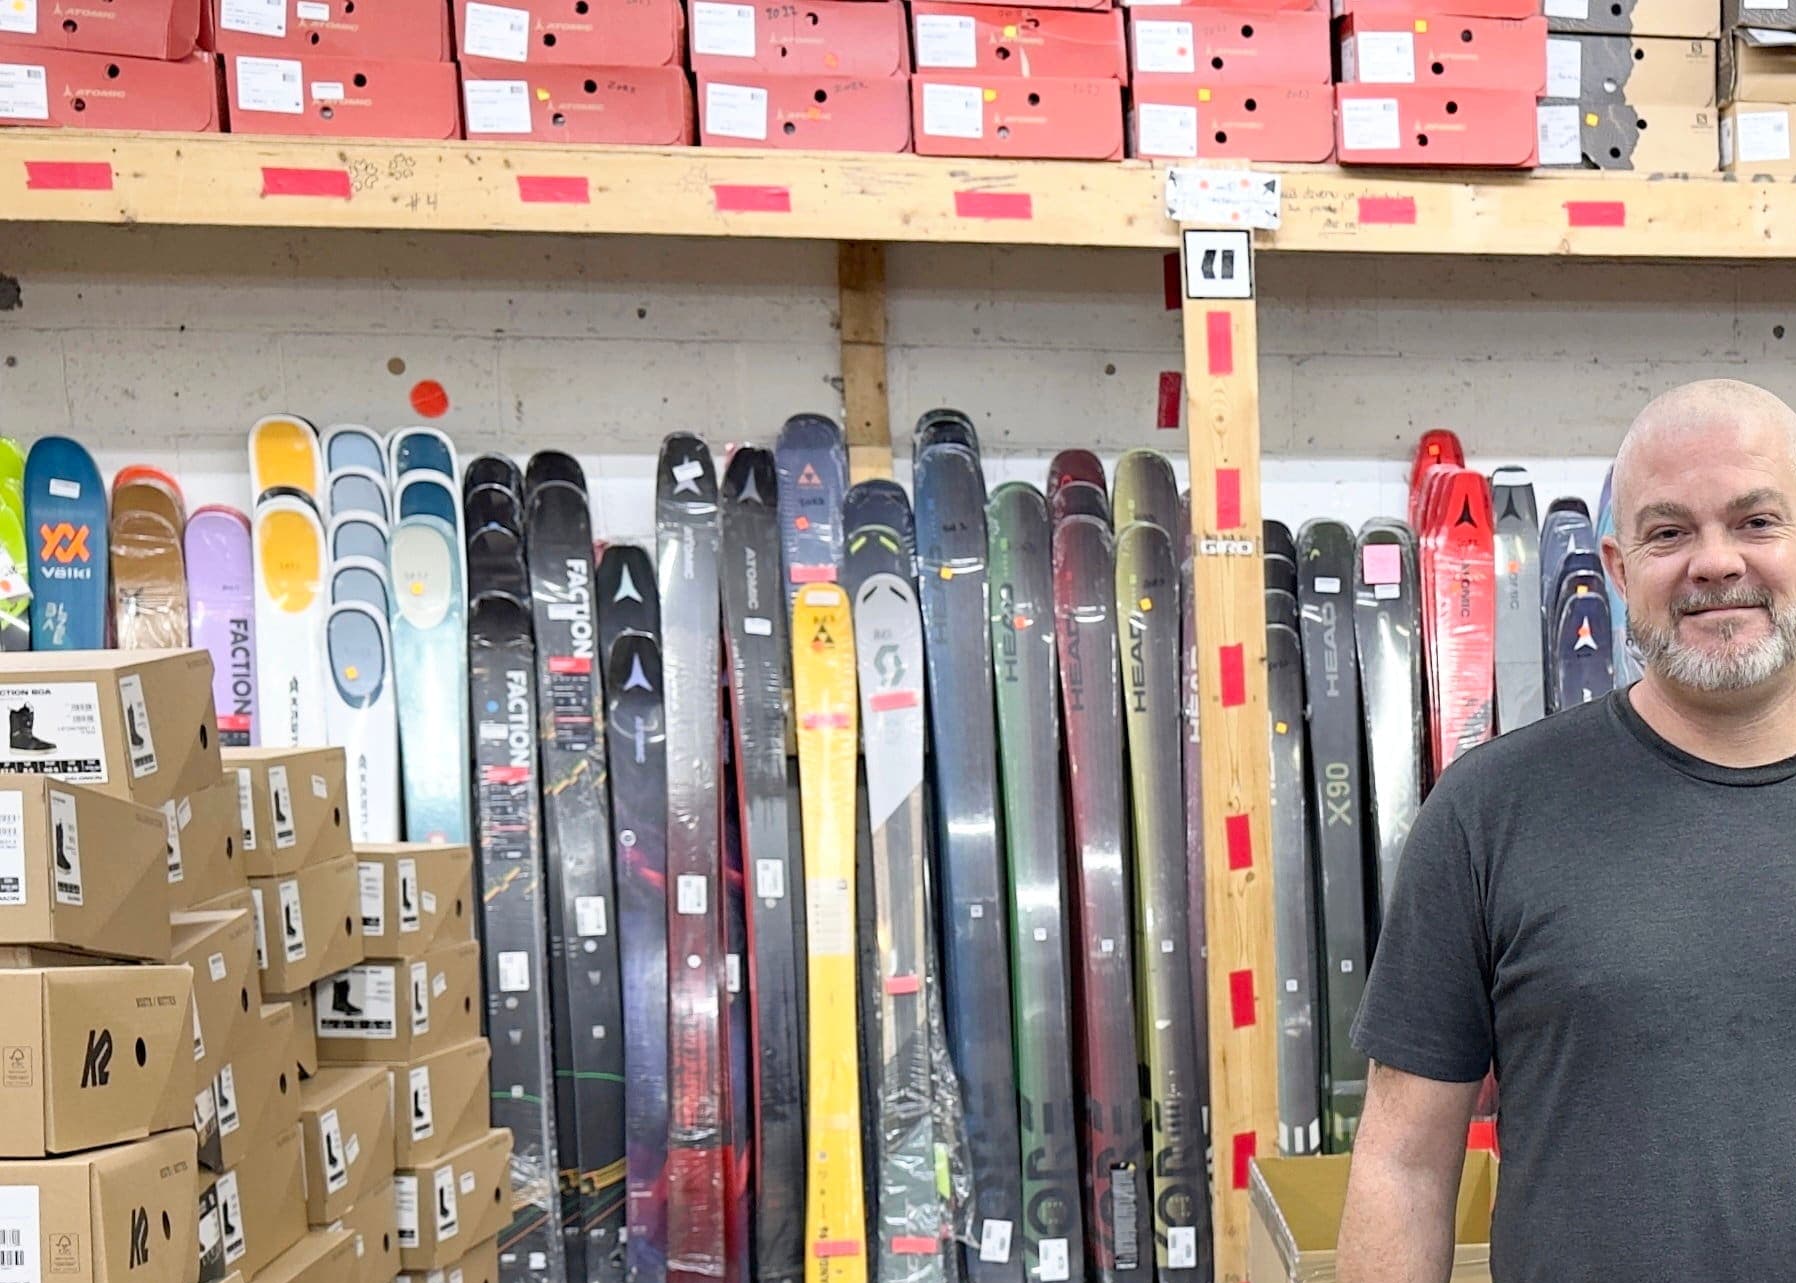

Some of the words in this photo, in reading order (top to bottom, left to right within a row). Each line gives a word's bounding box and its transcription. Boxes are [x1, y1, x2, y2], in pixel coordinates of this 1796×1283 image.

[41, 566, 92, 580] Völkl
[566, 559, 593, 658] FACTION
[745, 548, 759, 610] ATOMIC
[229, 619, 253, 717] FACTION
[1001, 584, 1018, 683] HEAD
[1070, 615, 1085, 711] HEAD
[1132, 619, 1148, 713] HEAD
[1321, 601, 1340, 697] HEAD
[505, 670, 531, 767] FACTION
[1325, 762, 1352, 827] X90
[81, 1029, 113, 1089] K2
[129, 1206, 149, 1270] K2
